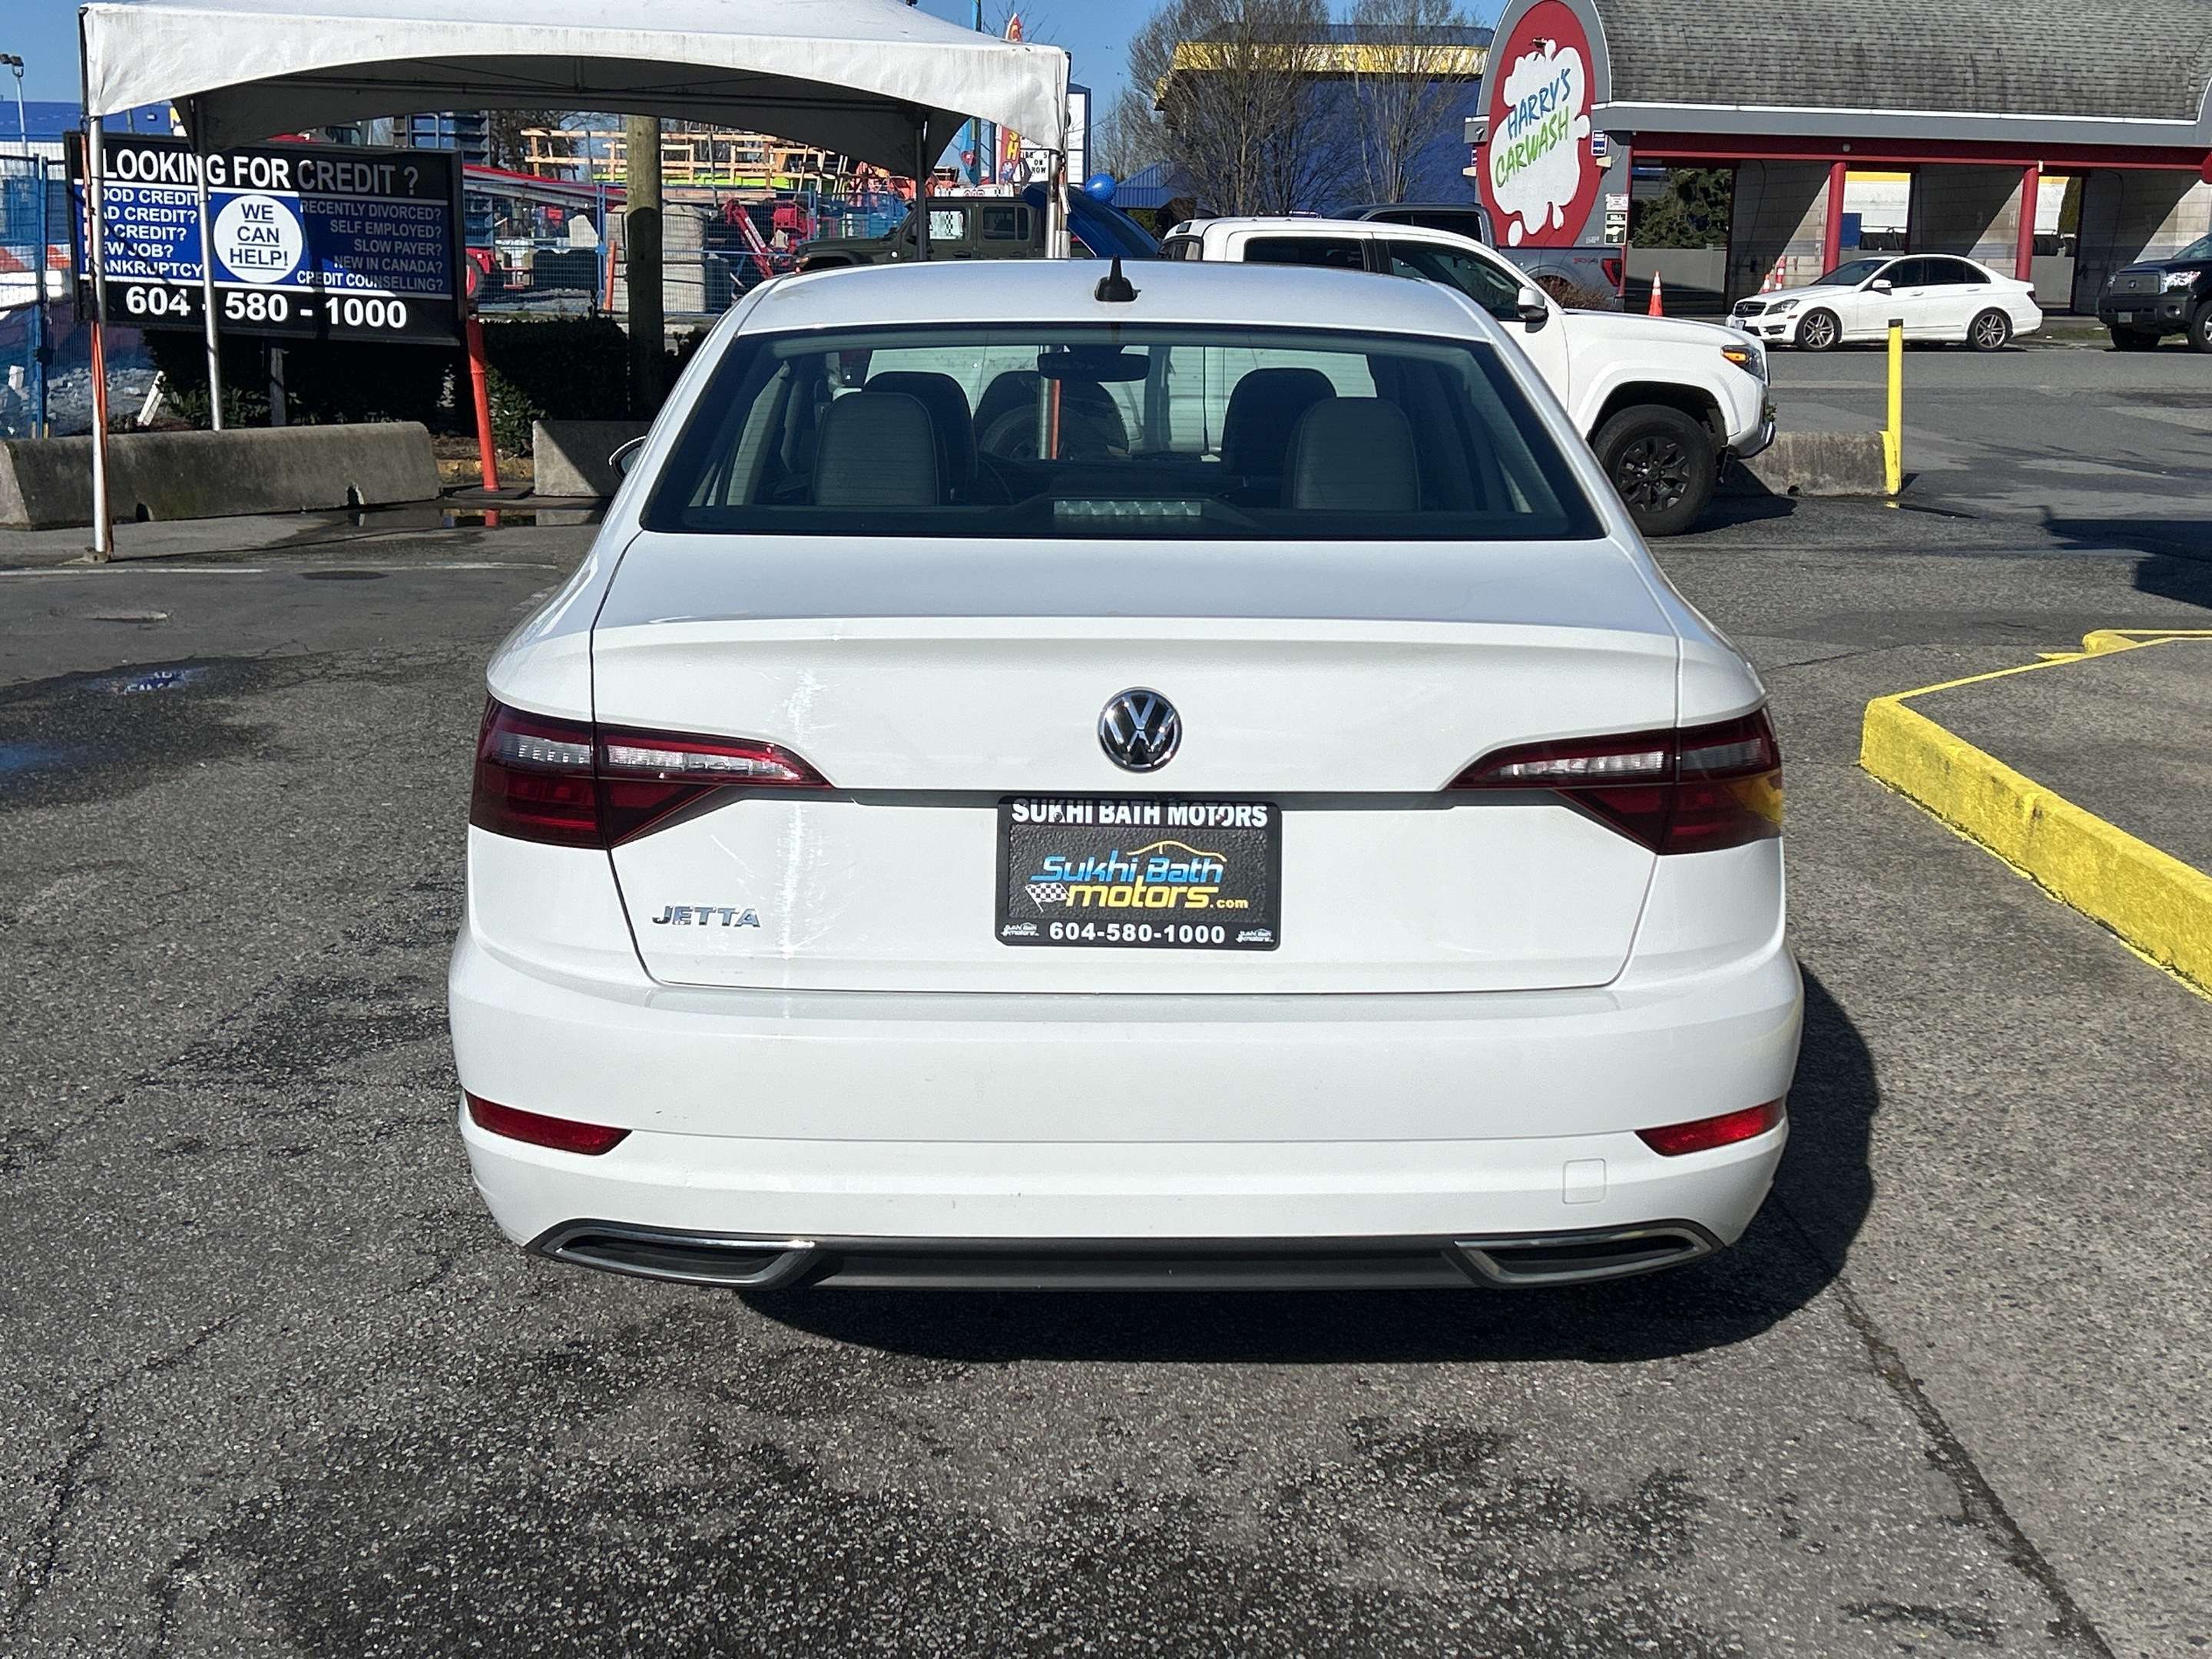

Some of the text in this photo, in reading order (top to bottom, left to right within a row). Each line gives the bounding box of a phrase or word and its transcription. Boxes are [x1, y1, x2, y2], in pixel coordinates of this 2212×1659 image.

[1508, 68, 1571, 140] HARRY'S
[1495, 105, 1568, 187] CARWASH
[102, 147, 419, 195] LOOKING FOR CREDIT ?
[139, 190, 212, 206] CREDIT
[124, 207, 197, 224] CREDIT?
[241, 204, 274, 220] WE
[300, 200, 442, 221] RECENTLY DIVORCED?
[114, 224, 187, 241] CREDIT?
[237, 226, 280, 243] CAN
[330, 220, 442, 239] SELF EMPLOYED?
[128, 243, 174, 259] JOB?
[230, 248, 288, 267] HELP!
[354, 238, 443, 257] SLOW PAYER?
[85, 257, 203, 277] NKRUPTCY
[334, 255, 443, 274] NEW IN CANADA?
[296, 270, 443, 290] CREDIT COUNSELLING?
[126, 286, 190, 316] 604
[225, 292, 288, 321] 580
[325, 297, 406, 328] 1000
[1012, 798, 1267, 827] SUKHI BATH MOTORS
[1031, 849, 1224, 883] Sukhi Bath
[652, 906, 760, 927] JETTA
[1049, 922, 1225, 944] 604-580-1000
